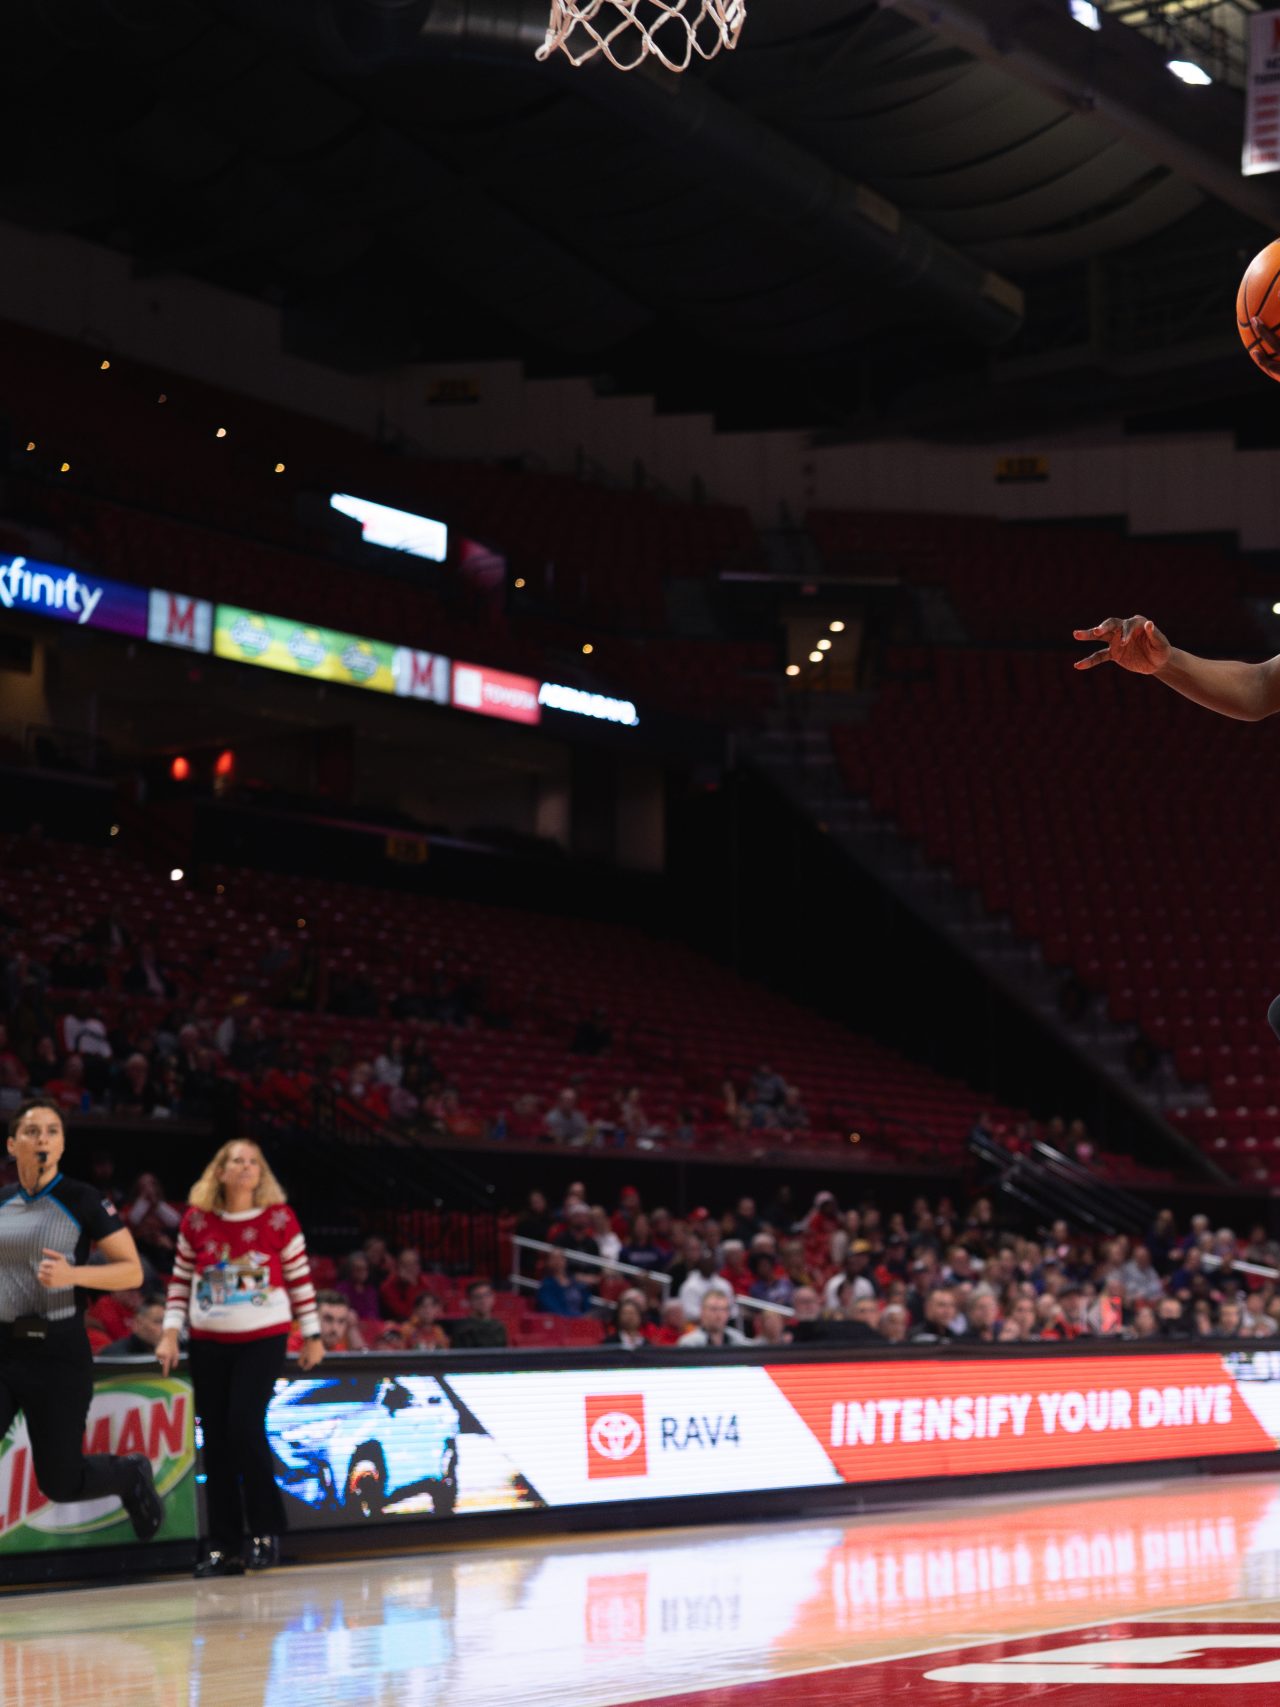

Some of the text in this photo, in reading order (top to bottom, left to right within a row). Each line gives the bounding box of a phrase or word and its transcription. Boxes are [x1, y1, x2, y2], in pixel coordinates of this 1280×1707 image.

[661, 1414, 740, 1450] RAV4
[830, 1384, 1233, 1447] INTENSIFY YOUR DRIVE
